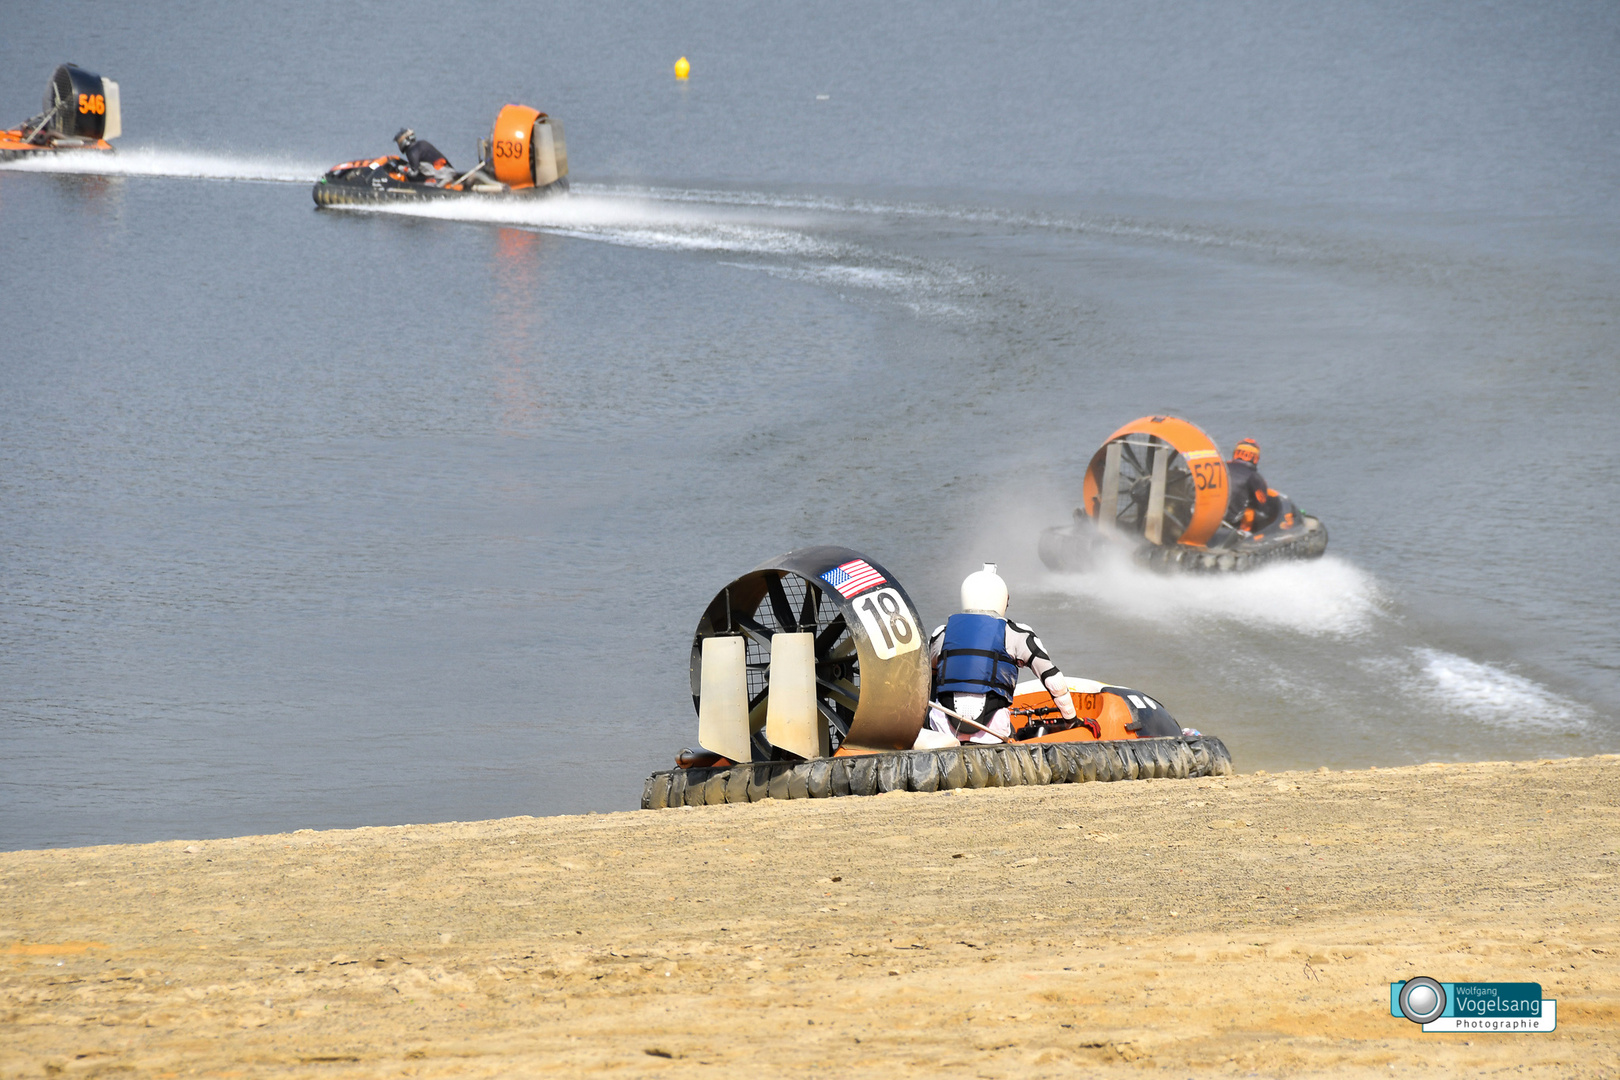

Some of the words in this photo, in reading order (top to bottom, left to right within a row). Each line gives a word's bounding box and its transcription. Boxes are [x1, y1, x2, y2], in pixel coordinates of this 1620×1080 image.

[79, 94, 105, 115] 546
[496, 141, 522, 159] 539
[1194, 462, 1222, 491] 527
[862, 592, 913, 650] 18
